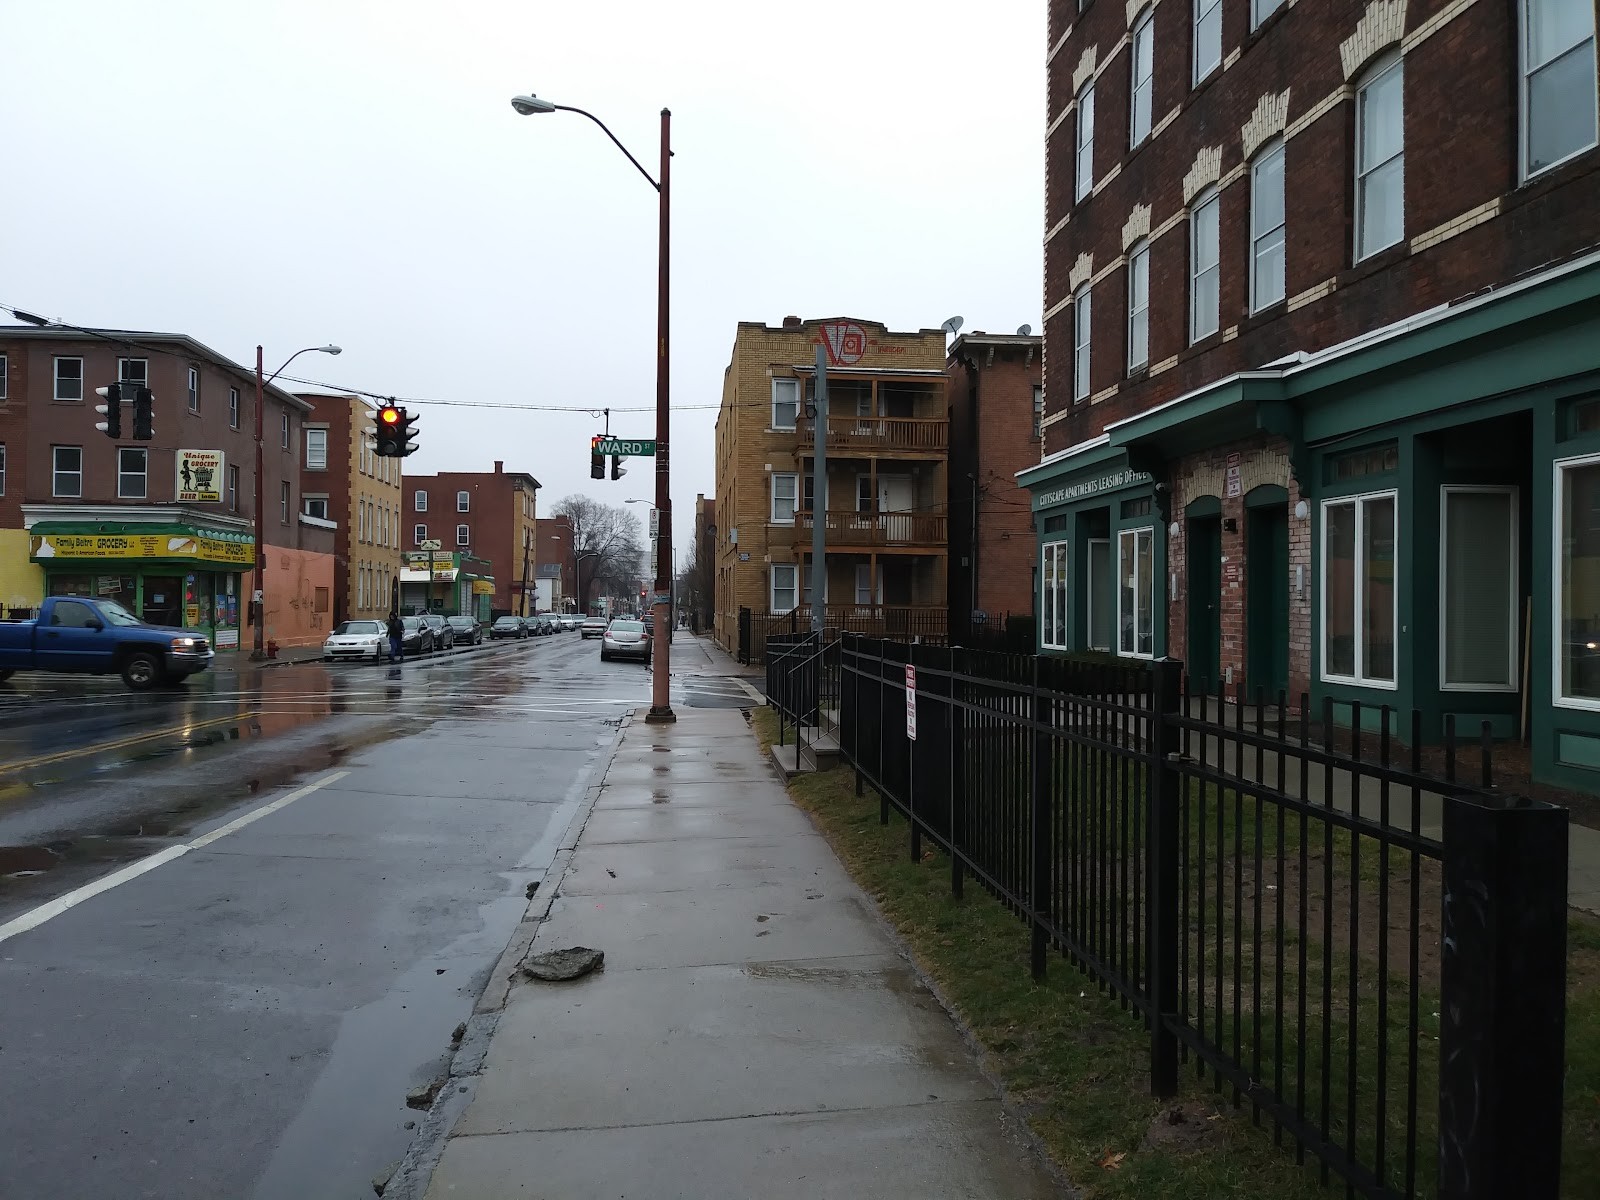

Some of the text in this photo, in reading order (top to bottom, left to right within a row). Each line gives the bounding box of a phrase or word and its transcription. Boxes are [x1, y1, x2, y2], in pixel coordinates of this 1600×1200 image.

[597, 441, 643, 454] WARD
[184, 452, 216, 460] Unique
[190, 460, 219, 468] GROCERY
[1040, 489, 1065, 506] CITYSCAPE
[1064, 479, 1098, 499] APARTMENTS
[1098, 472, 1123, 490] LEASING
[180, 492, 197, 500] BEER
[55, 538, 75, 549] Family
[96, 538, 128, 549] GROCERY
